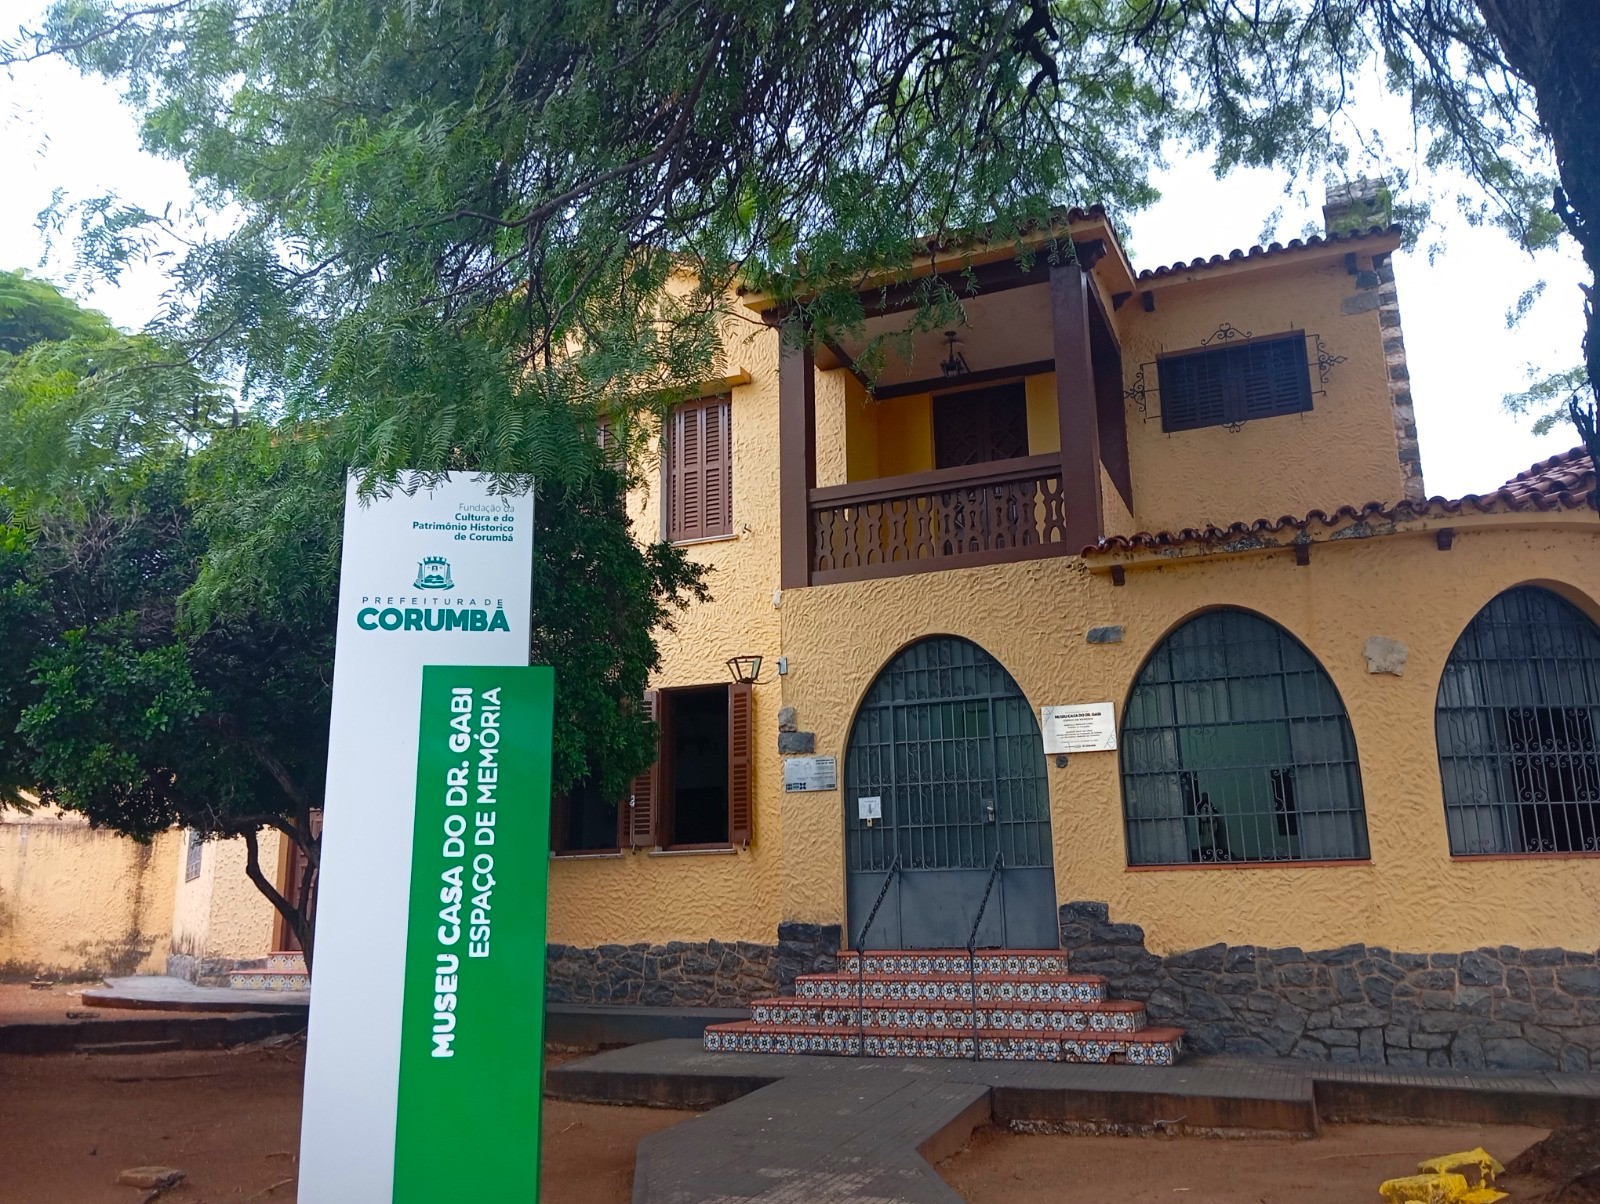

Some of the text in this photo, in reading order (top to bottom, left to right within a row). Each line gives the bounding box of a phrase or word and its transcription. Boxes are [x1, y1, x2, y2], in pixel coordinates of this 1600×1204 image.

[459, 503, 500, 514] Fundação
[455, 513, 490, 522] Cultura
[501, 513, 514, 522] do
[412, 521, 514, 532] Patrimônio Historico
[454, 532, 514, 542] de Corumbá
[362, 596, 503, 606] PREFEITURA DE
[356, 606, 511, 632] CORUMBÁ
[468, 686, 502, 958] ESPAÇO DE MEMÓRIA
[431, 687, 473, 1058] MUSEU CASA DO DR. GABI
